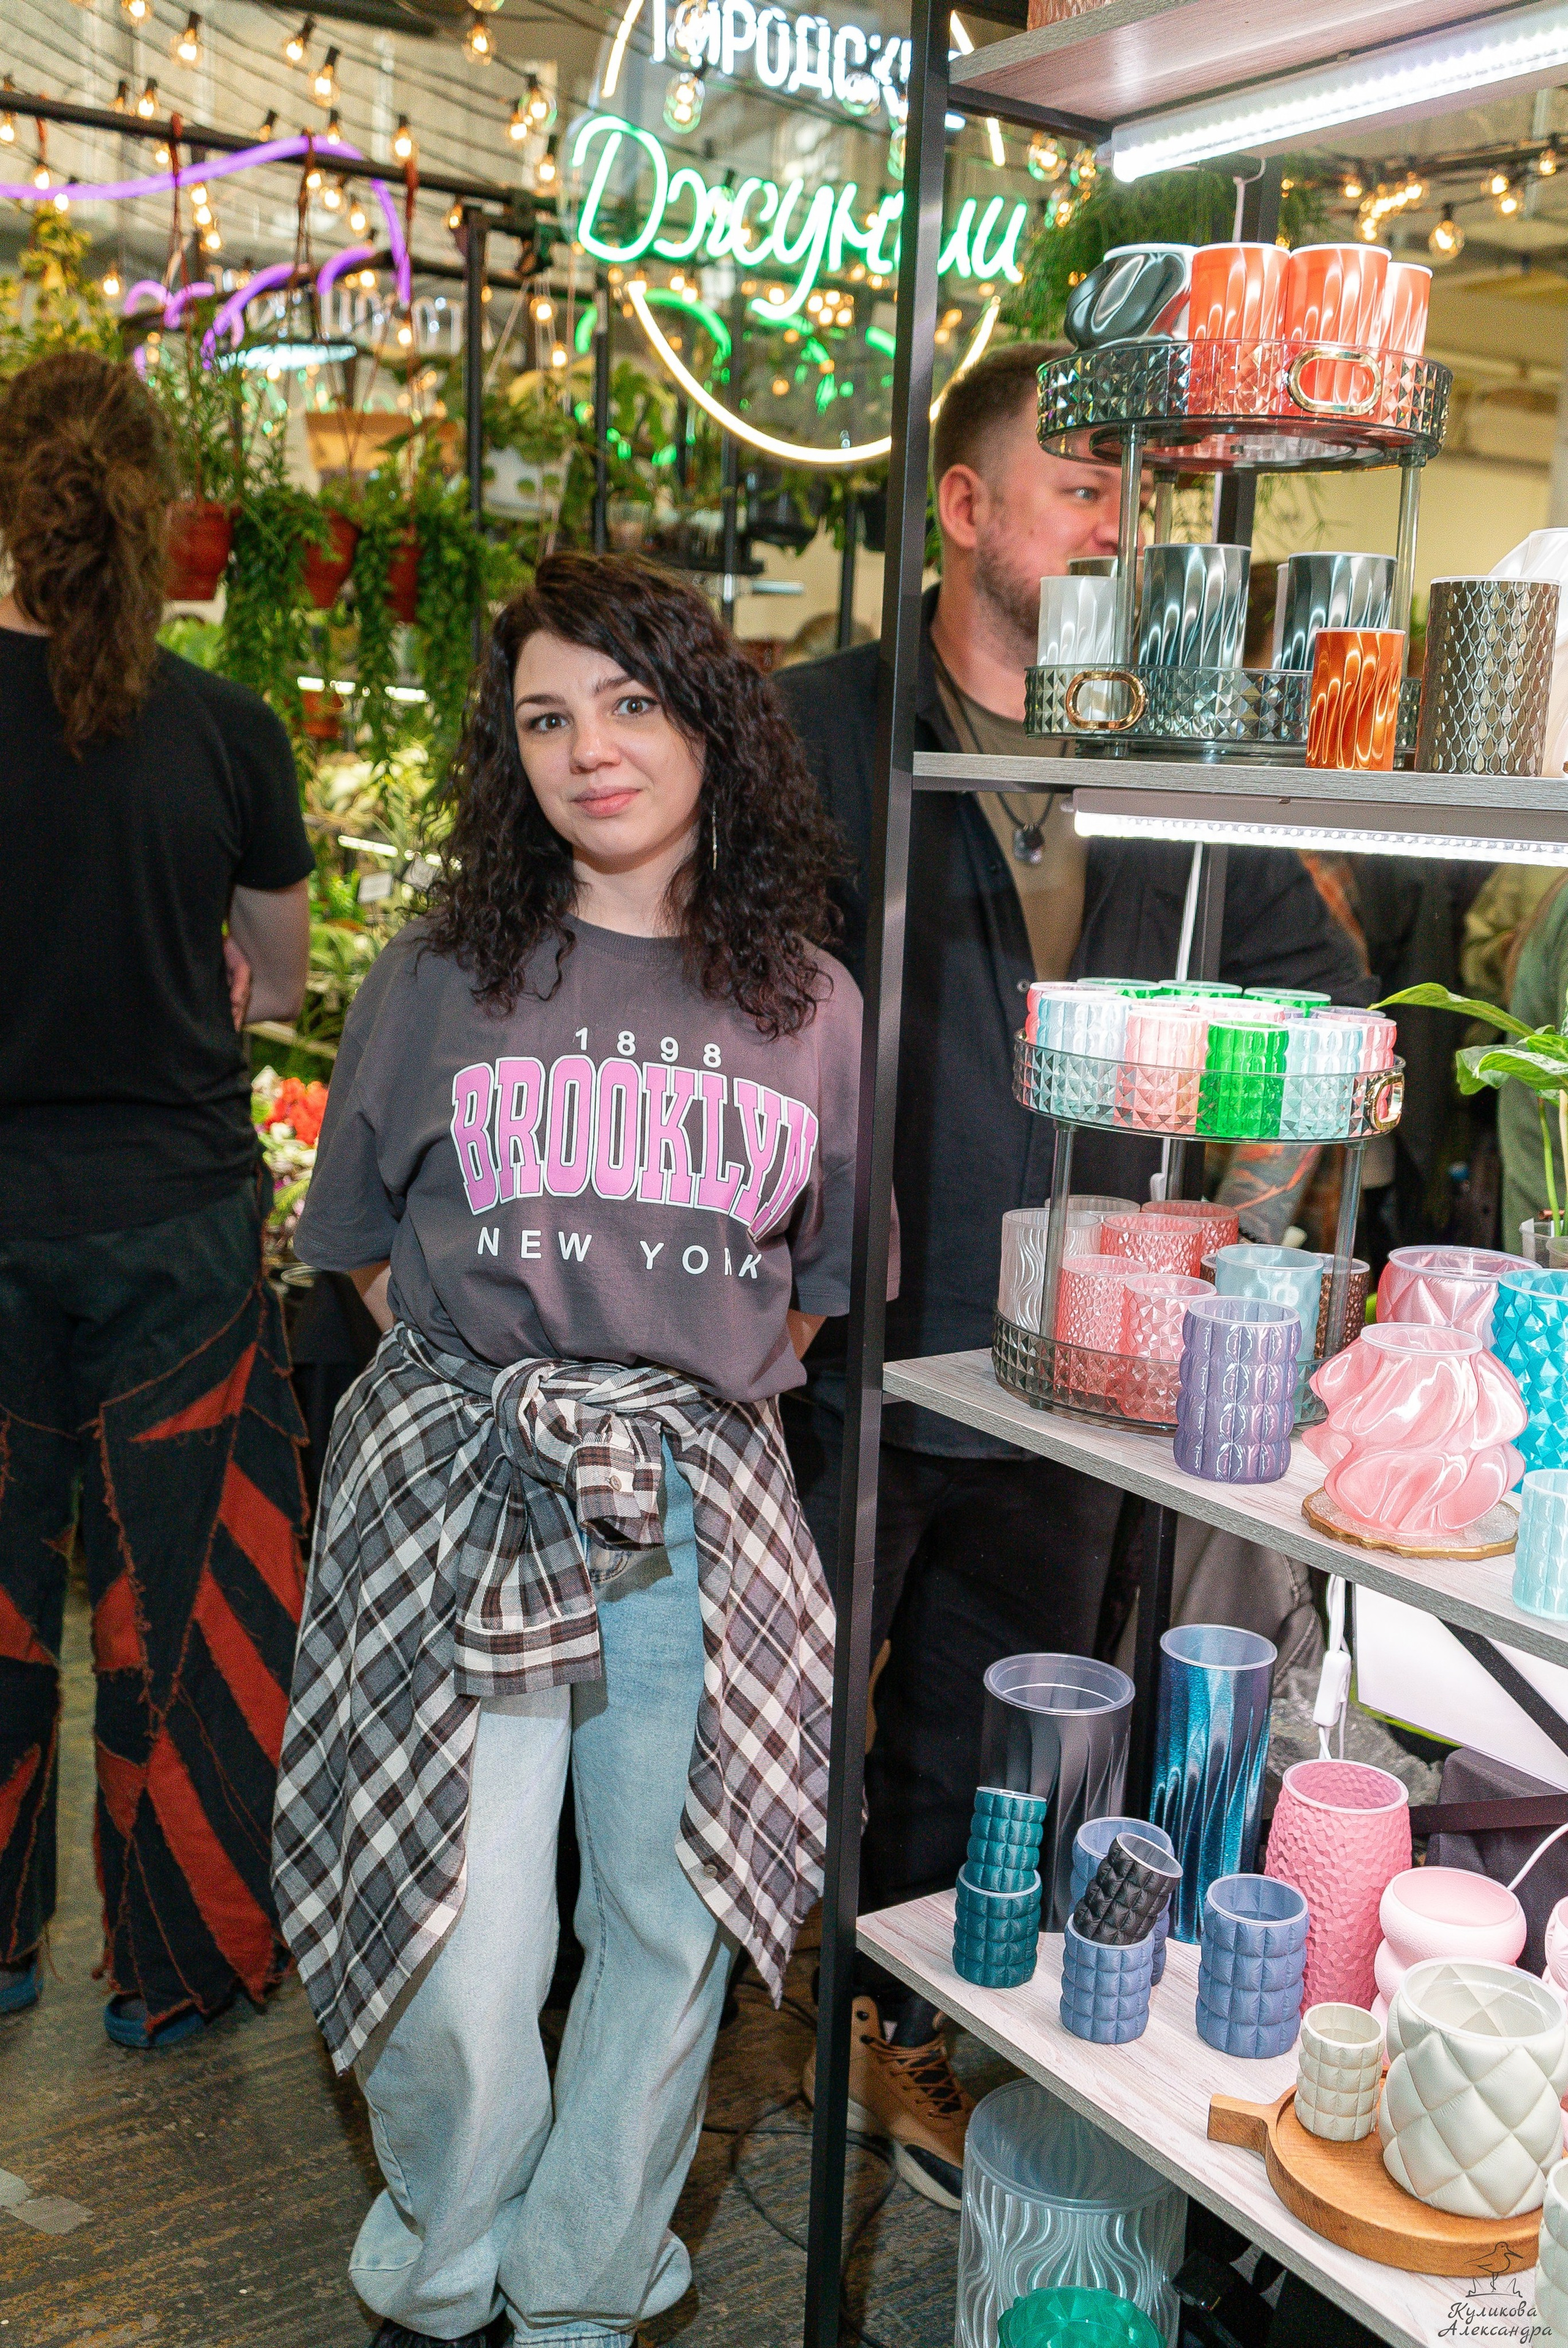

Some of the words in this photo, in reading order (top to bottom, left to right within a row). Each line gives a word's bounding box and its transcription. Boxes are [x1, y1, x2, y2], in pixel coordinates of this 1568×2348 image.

[575, 1027, 722, 1068] 1898
[450, 1054, 820, 1244] BROOKLYN
[477, 1226, 592, 1263] NEW
